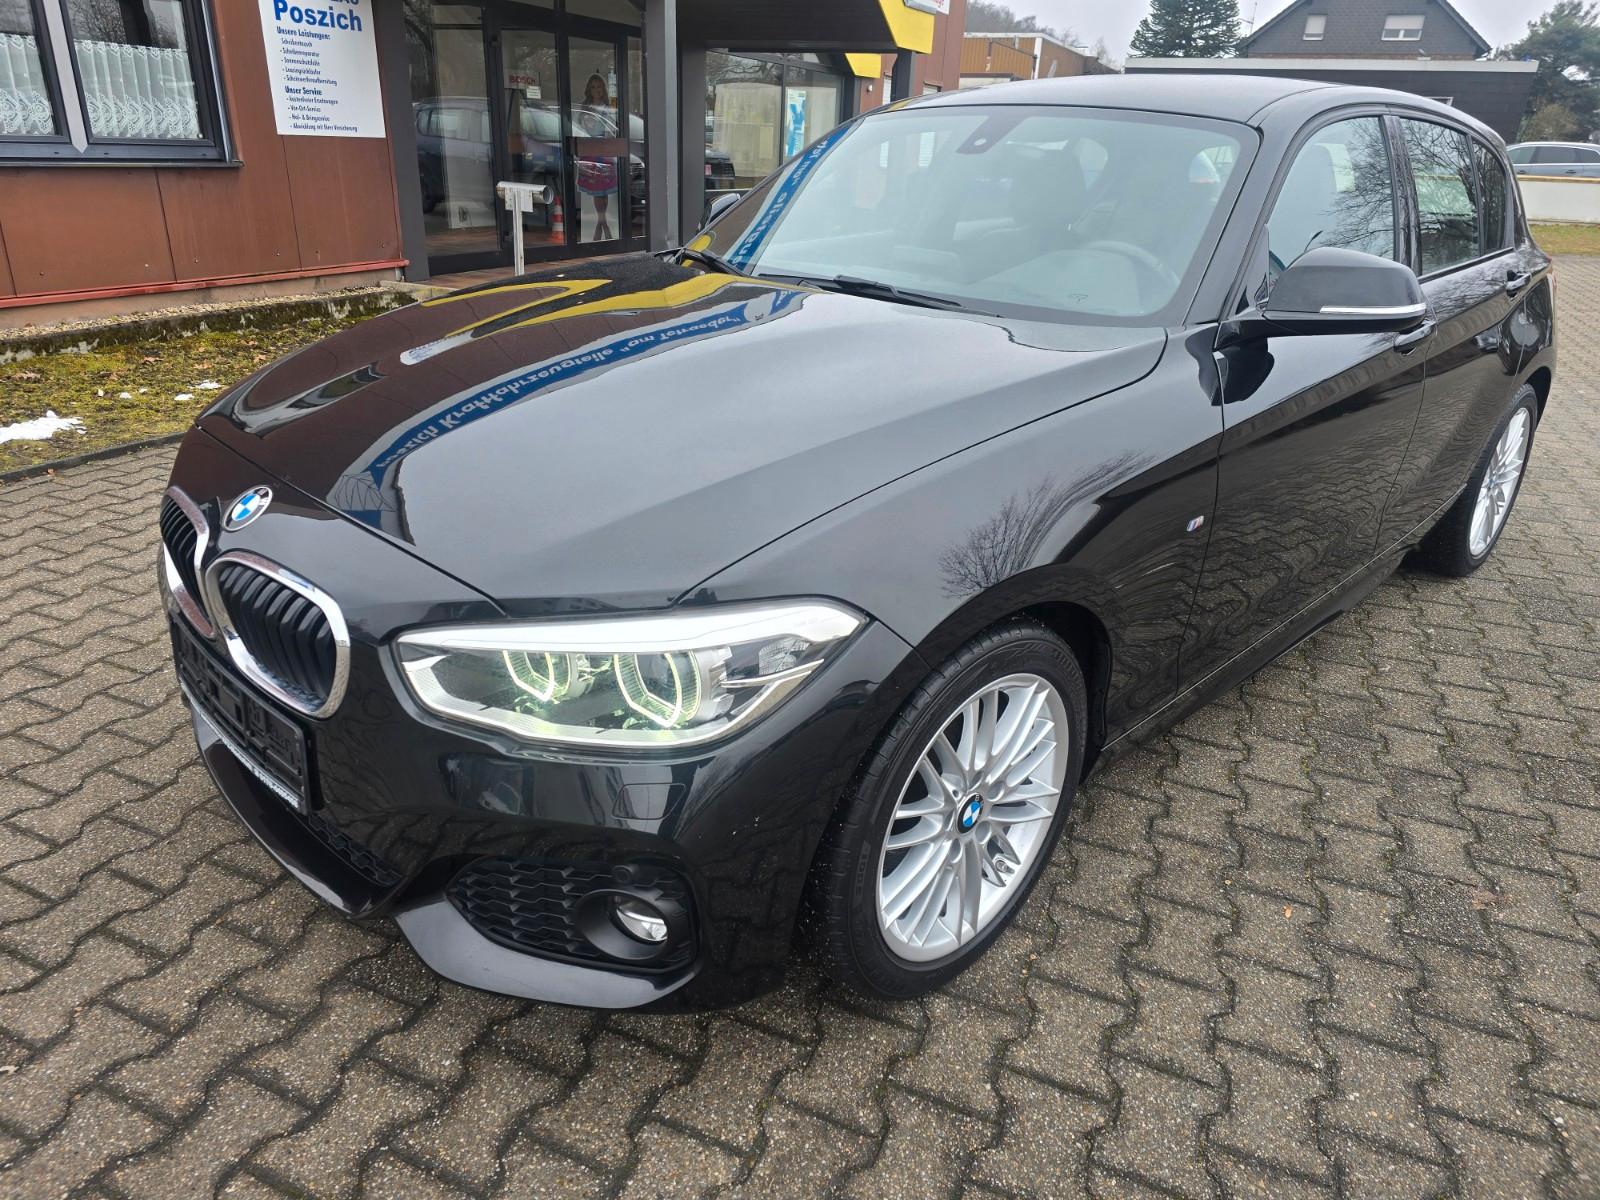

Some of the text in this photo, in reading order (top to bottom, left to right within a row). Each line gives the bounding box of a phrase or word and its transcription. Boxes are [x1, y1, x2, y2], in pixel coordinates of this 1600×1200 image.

[273, 0, 362, 31] Poszich
[276, 25, 331, 40] Unsere Leistungen:
[285, 86, 323, 96] Unser Service
